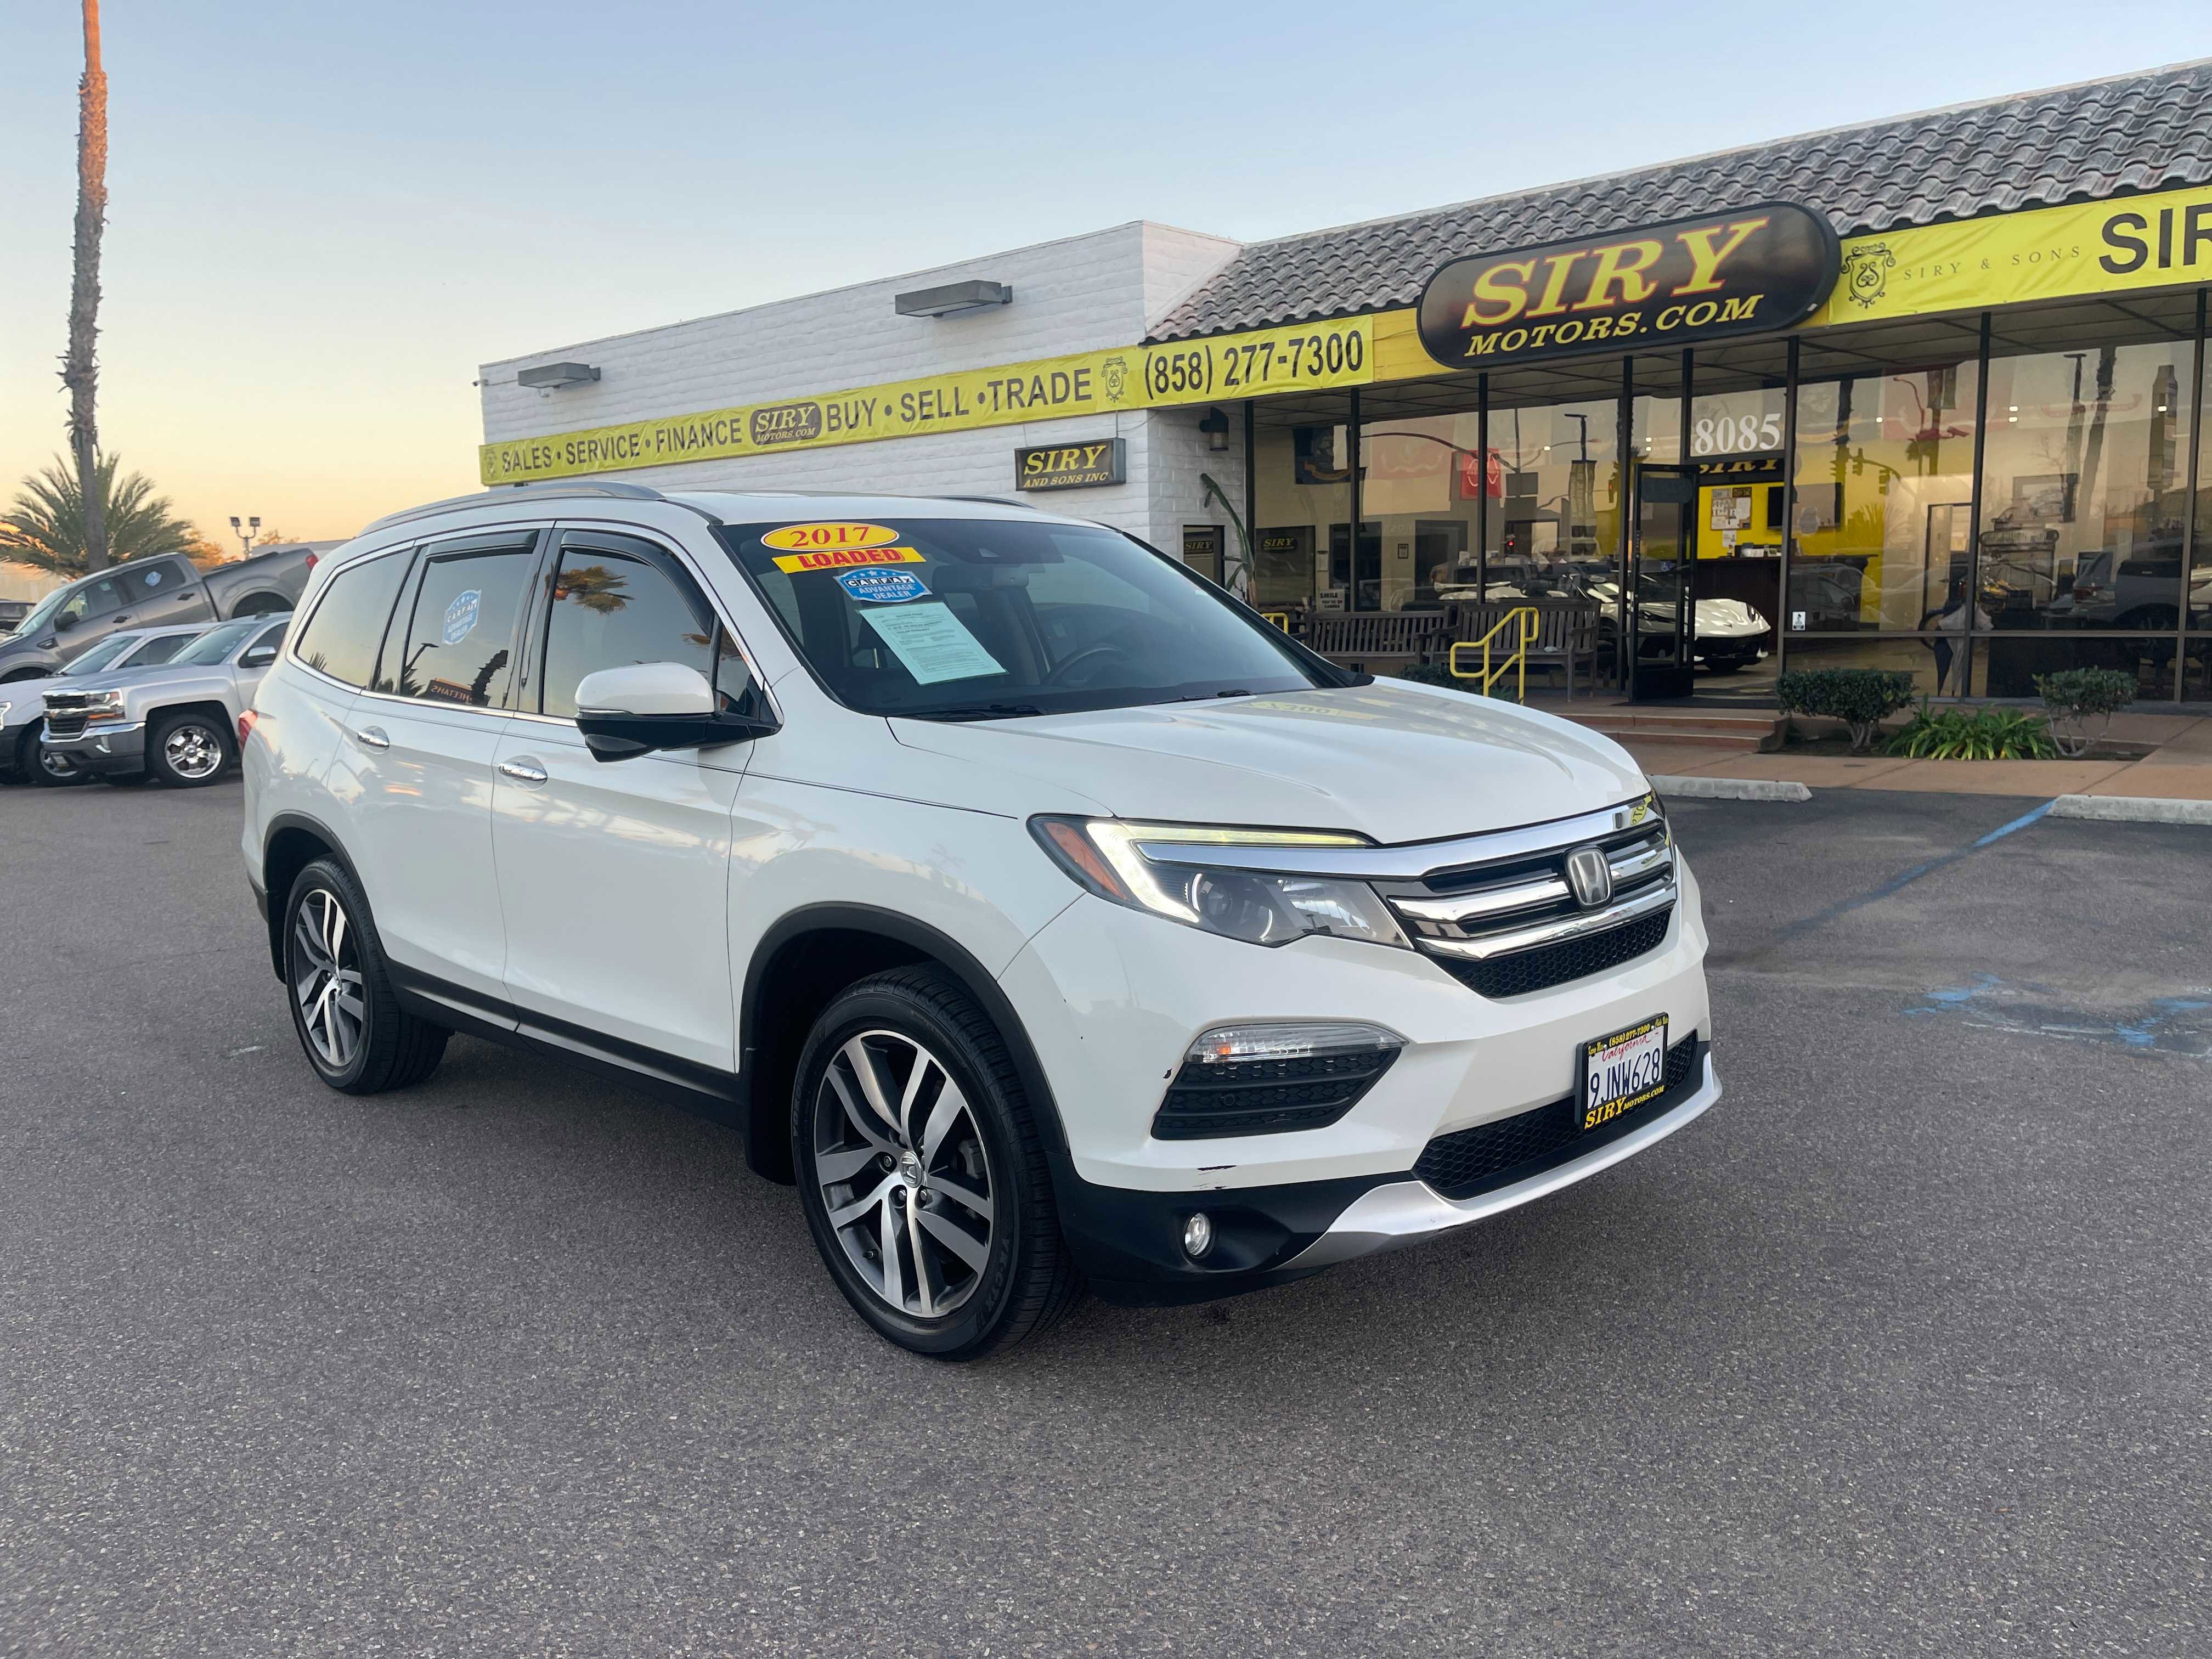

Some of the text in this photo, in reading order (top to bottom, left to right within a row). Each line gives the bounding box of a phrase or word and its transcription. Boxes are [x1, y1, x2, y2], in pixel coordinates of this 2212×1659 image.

[1460, 217, 1770, 329] SIRY
[1904, 246, 2080, 280] SIRY & SONS
[1464, 295, 1763, 357] MOTORS.COM
[1145, 330, 1363, 400] (858) 277-7300
[827, 368, 1092, 431] BUY SELL TRADE
[755, 406, 815, 433] SIRY
[1695, 413, 1781, 454] 8085
[503, 418, 743, 472] SALES SERVICE FINANCE
[755, 427, 816, 442] MOTORS.COM
[1024, 445, 1107, 475] SIRY
[1023, 472, 1109, 488] AND SONS INC
[789, 526, 869, 547] 2017
[1263, 538, 1295, 547] SIRY
[797, 549, 905, 569] LOADED
[847, 576, 915, 588] CARFAX
[859, 584, 916, 594] ADVANTAGE
[873, 591, 912, 599] DEALER
[1590, 1048, 1660, 1107] 9JNW628
